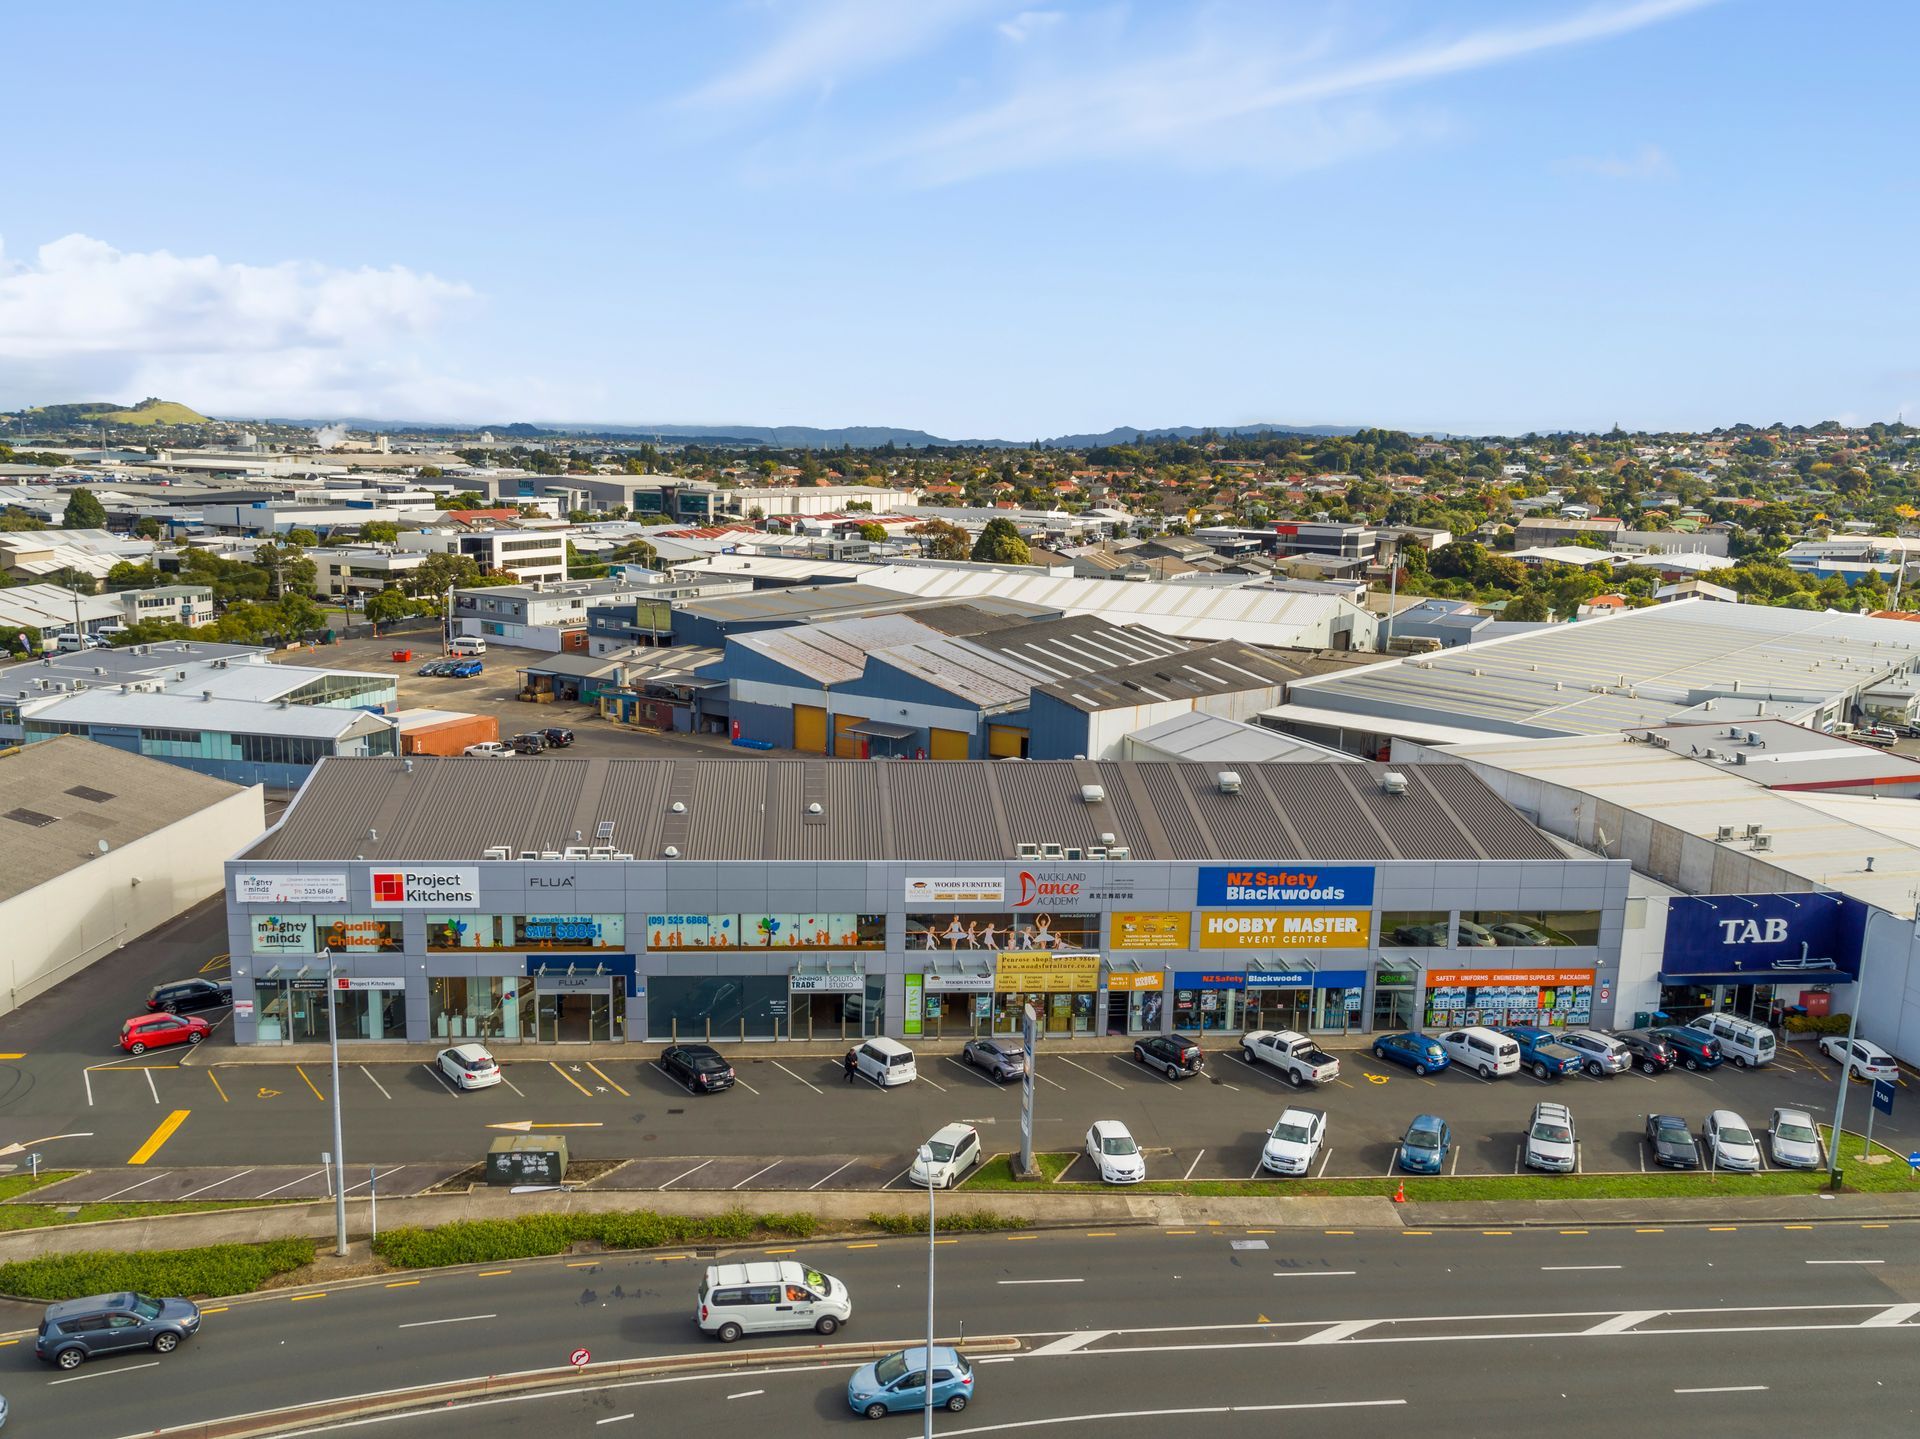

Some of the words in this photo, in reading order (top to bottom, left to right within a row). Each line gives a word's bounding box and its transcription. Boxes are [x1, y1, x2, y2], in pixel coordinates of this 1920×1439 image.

[406, 873, 461, 888] Project
[530, 877, 575, 887] FLUA
[1037, 872, 1087, 881] AUCKLAND
[1227, 872, 1254, 886] NZ
[1255, 872, 1318, 888] Safety
[1010, 871, 1080, 907] Dance
[1226, 886, 1345, 901] Blackwoods
[406, 890, 474, 902] Kitchens
[1037, 897, 1080, 905] ACADEMY
[648, 916, 665, 926] (09)
[667, 916, 685, 925] 525
[686, 916, 708, 925] 6868
[1208, 918, 1278, 934] HOBBY
[1283, 917, 1358, 933] MASTER
[333, 921, 387, 933] Quality
[526, 925, 553, 938] SAVE
[556, 923, 602, 939] $885!
[1719, 918, 1789, 944] TAB
[267, 933, 302, 944] minds
[328, 935, 393, 946] Childcare
[1240, 935, 1276, 944] EVENT
[1283, 935, 1328, 944] CENTRE
[1202, 975, 1215, 983] NZ
[1215, 975, 1244, 984] Safety
[1248, 974, 1302, 983] Blackwoods
[791, 981, 816, 989] TRADE
[1875, 1090, 1889, 1103] TAB
